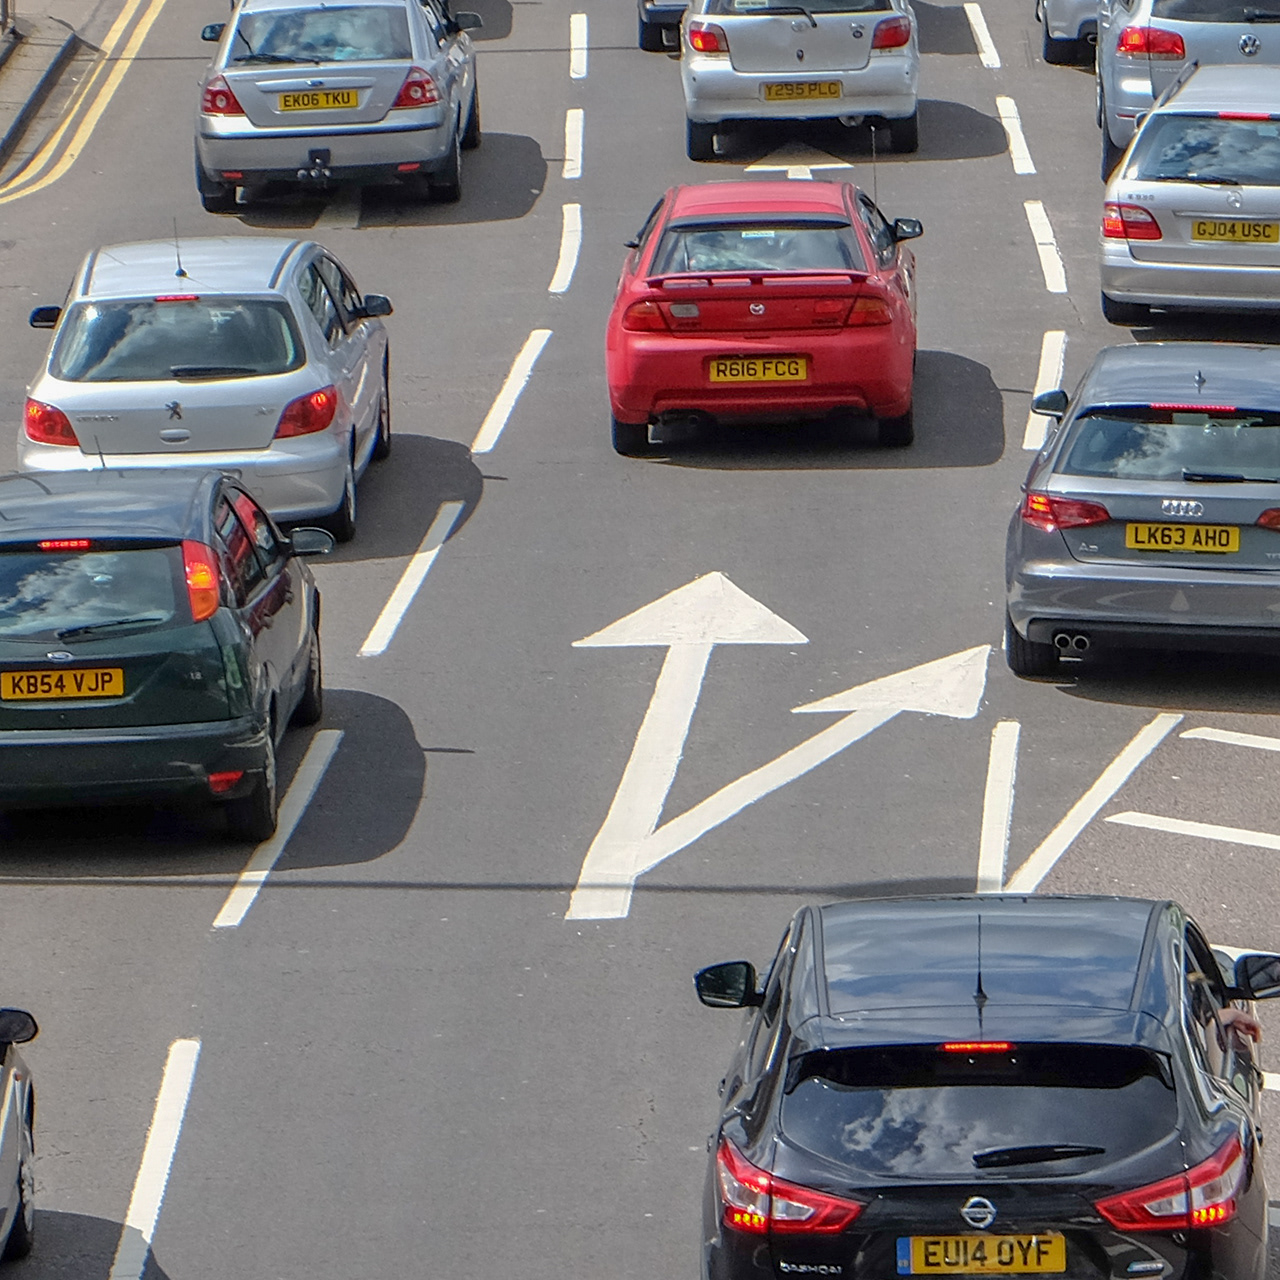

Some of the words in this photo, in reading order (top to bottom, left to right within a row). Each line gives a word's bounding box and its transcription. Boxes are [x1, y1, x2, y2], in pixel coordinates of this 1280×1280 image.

[766, 83, 805, 96] Y295
[808, 82, 838, 95] PLC
[283, 93, 320, 108] EK06
[323, 91, 351, 105] TKU
[1196, 222, 1237, 238] GJ04
[1241, 223, 1273, 239] USC
[716, 362, 757, 378] R616
[762, 360, 800, 376] FCG
[1133, 527, 1186, 546] LK63
[1192, 529, 1231, 548] AHO
[11, 674, 66, 695] KB54
[72, 672, 114, 693] VJP
[922, 1239, 988, 1269] EU14
[997, 1238, 1053, 1267] OYF
